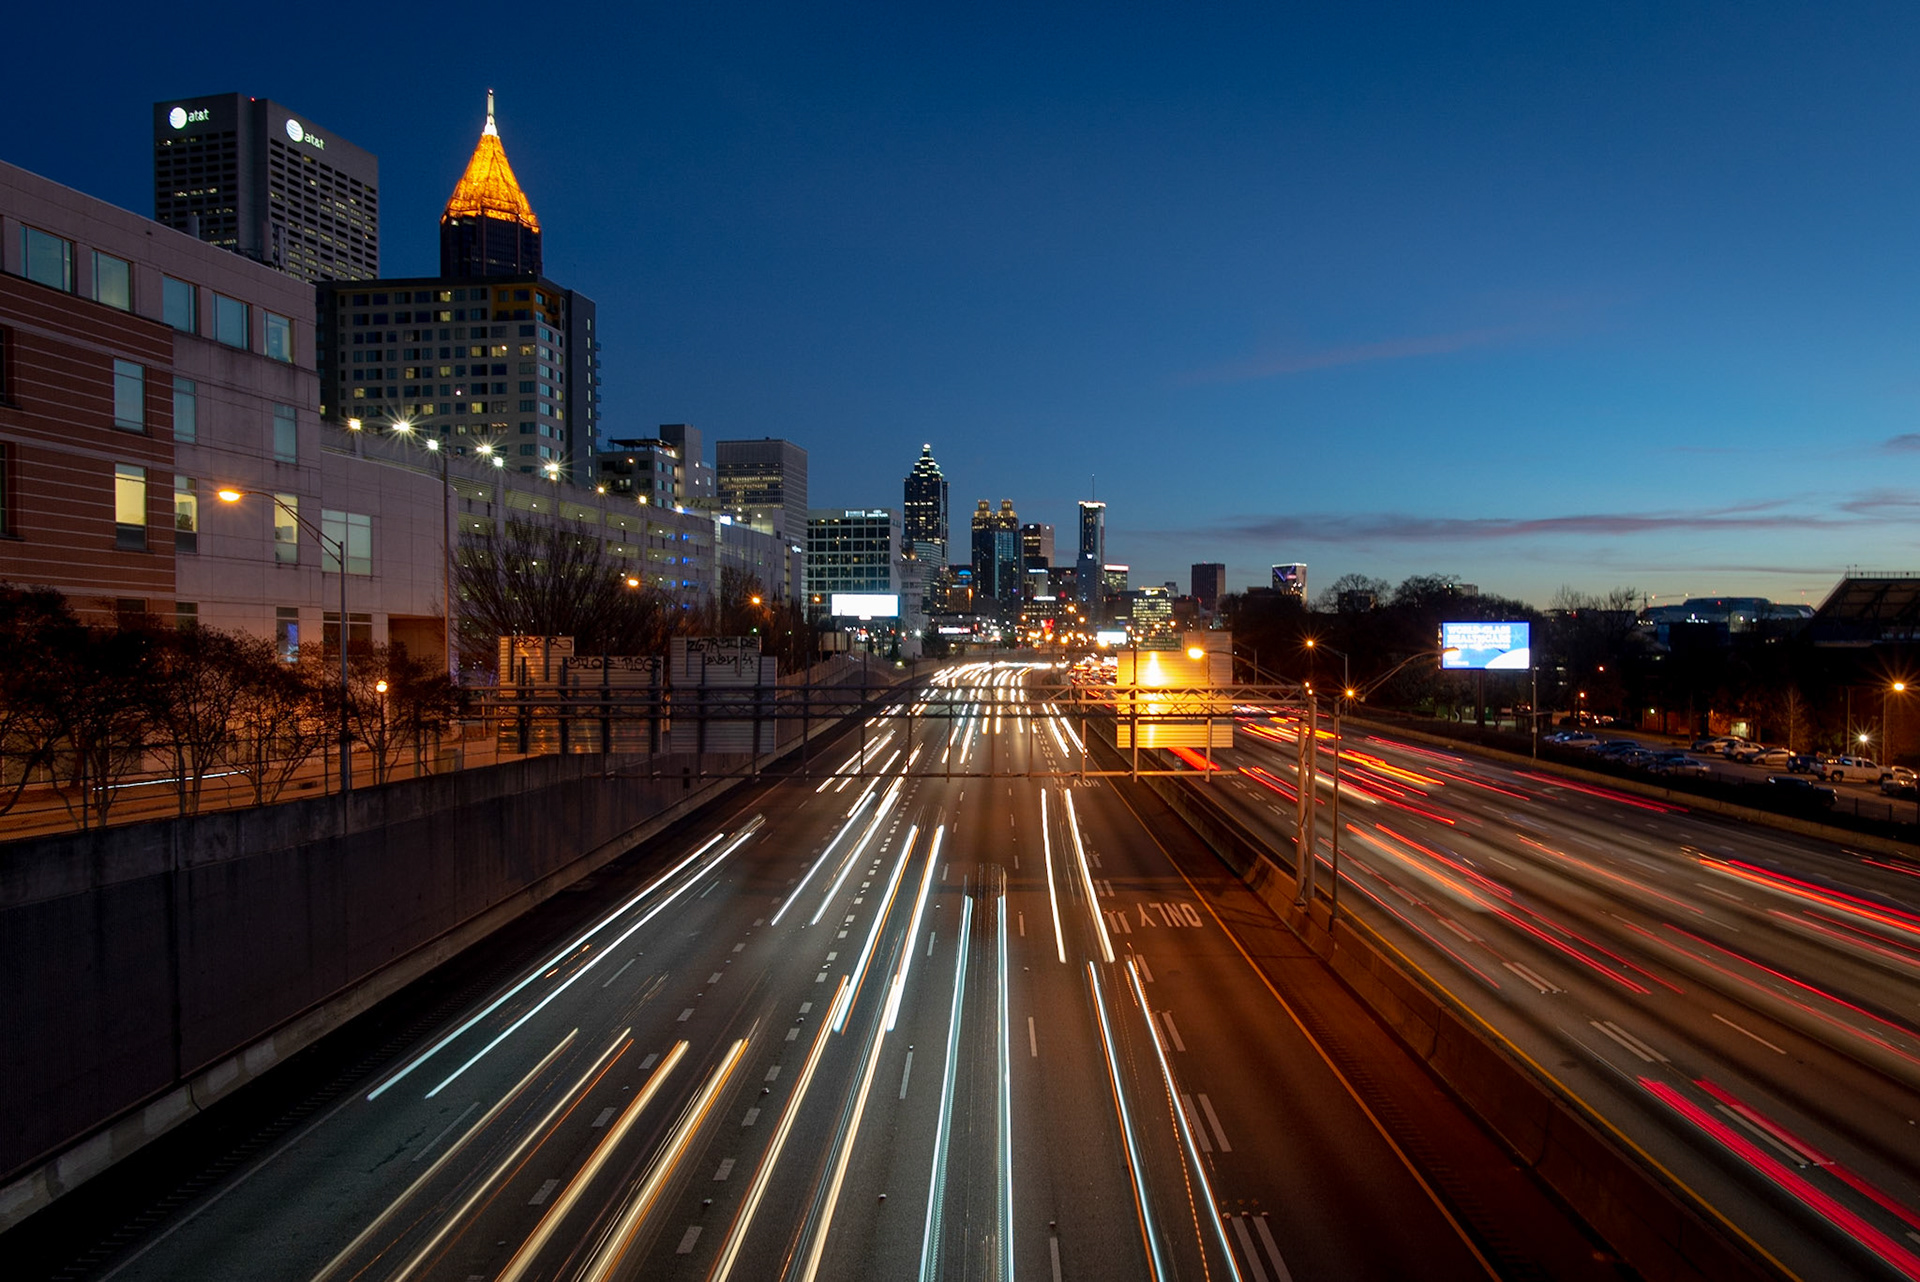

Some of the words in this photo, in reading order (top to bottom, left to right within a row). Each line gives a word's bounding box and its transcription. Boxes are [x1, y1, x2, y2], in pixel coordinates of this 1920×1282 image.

[188, 108, 210, 122] at&t
[304, 132, 326, 151] at&t
[1136, 902, 1204, 928] ONLY
